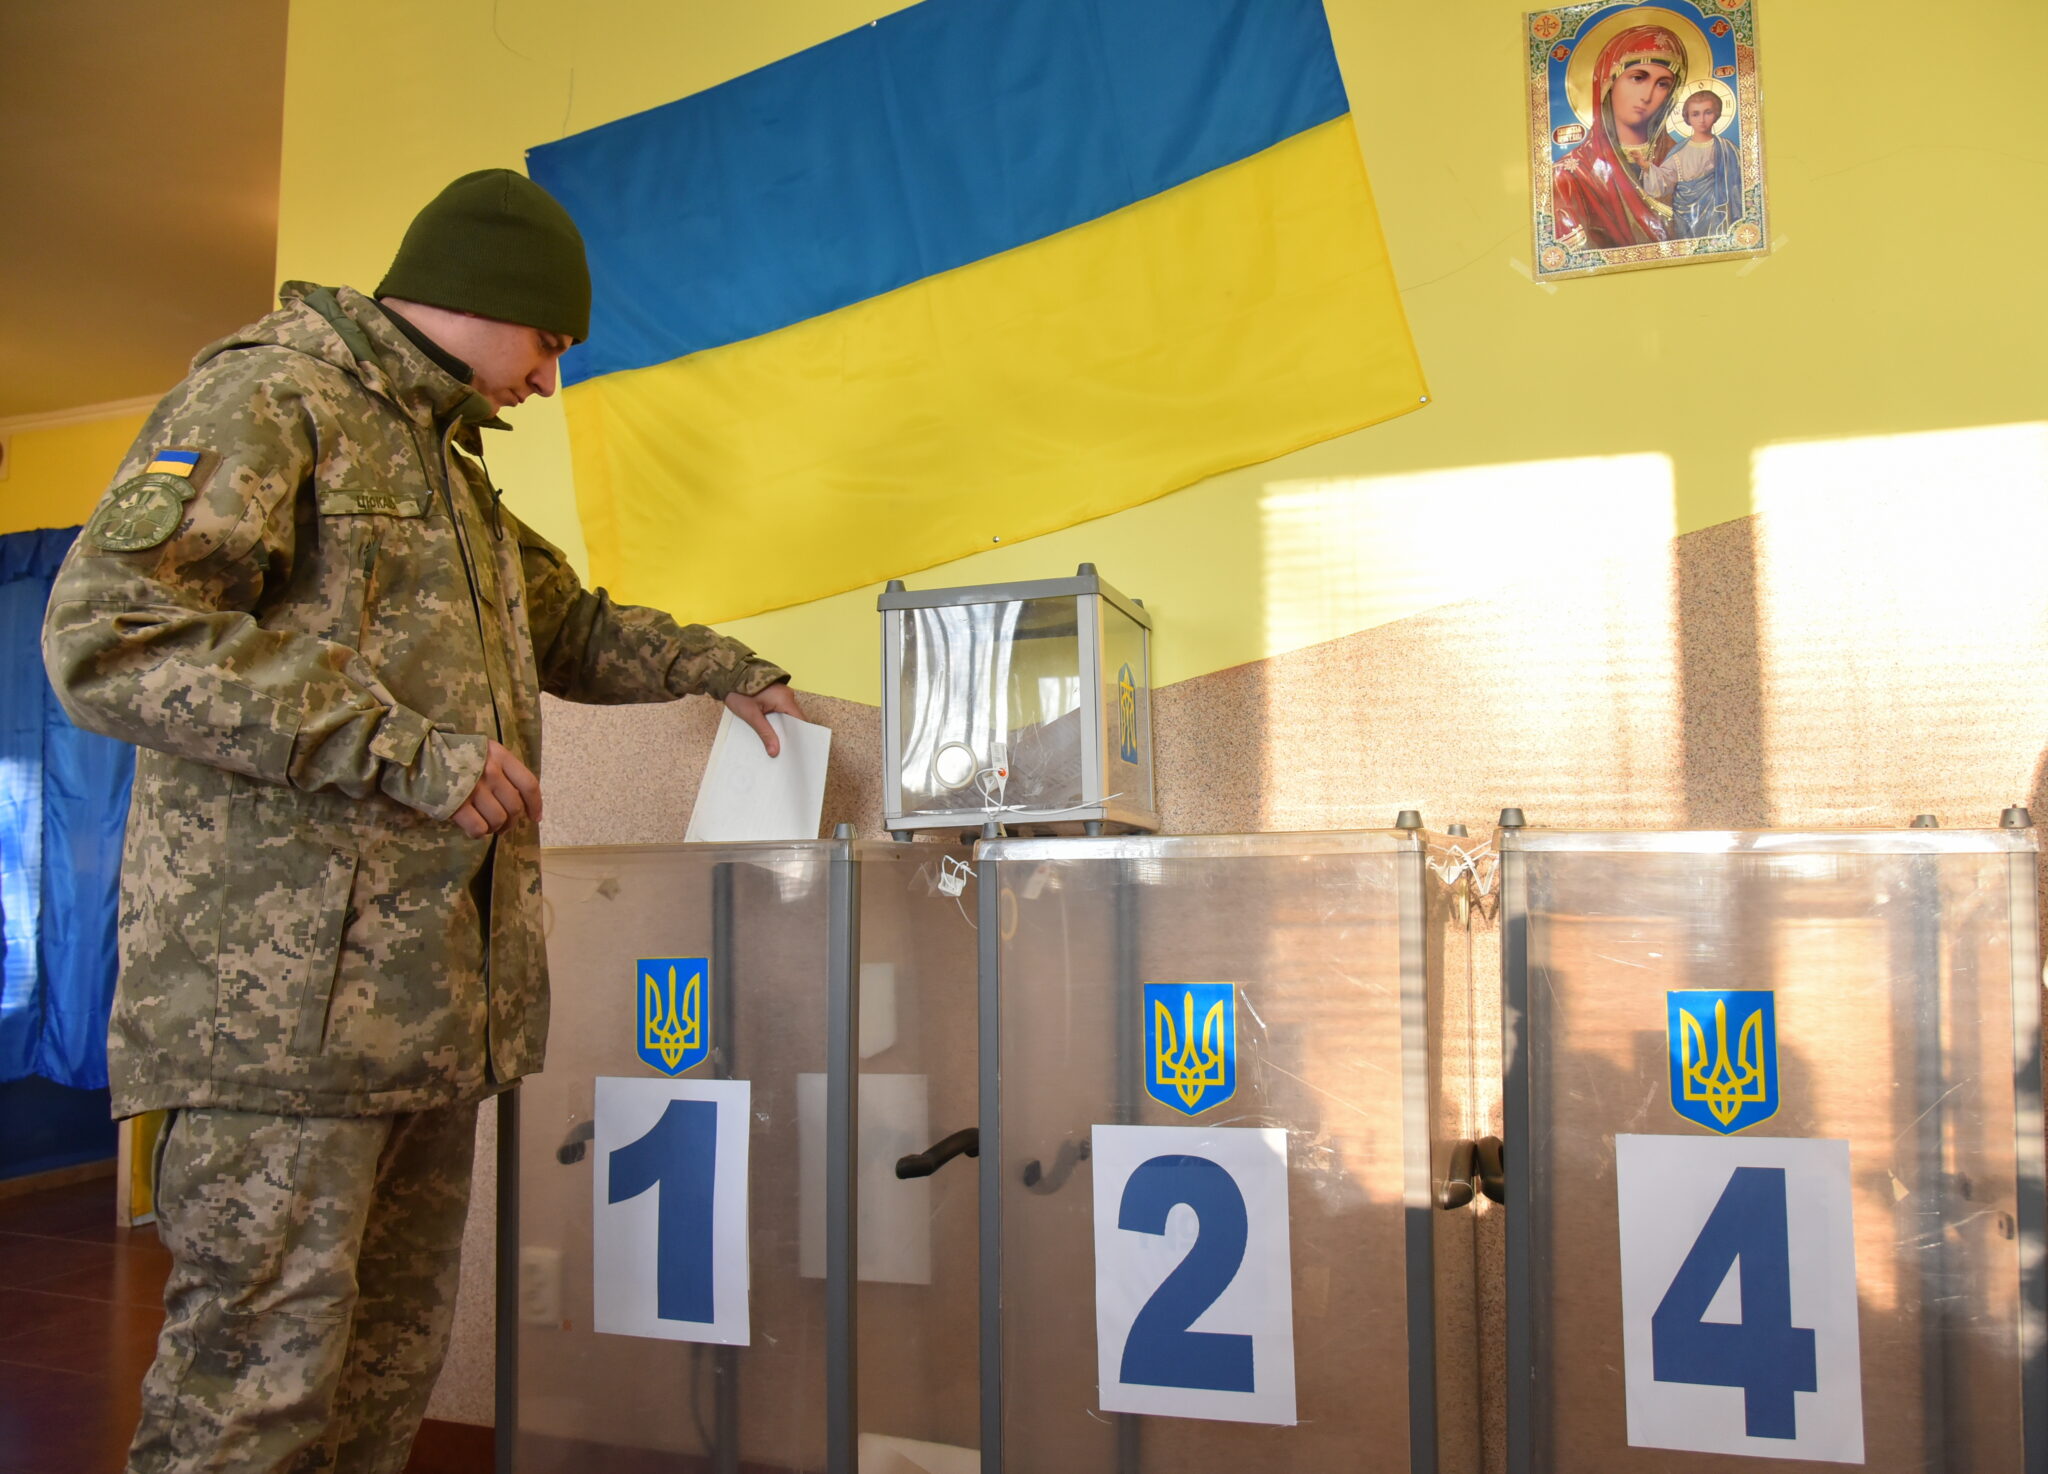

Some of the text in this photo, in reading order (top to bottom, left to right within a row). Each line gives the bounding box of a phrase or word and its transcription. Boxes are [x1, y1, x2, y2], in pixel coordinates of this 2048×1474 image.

[609, 1099, 717, 1324] 1
[1118, 1155, 1255, 1393] 2
[1652, 1166, 1817, 1440] 4
